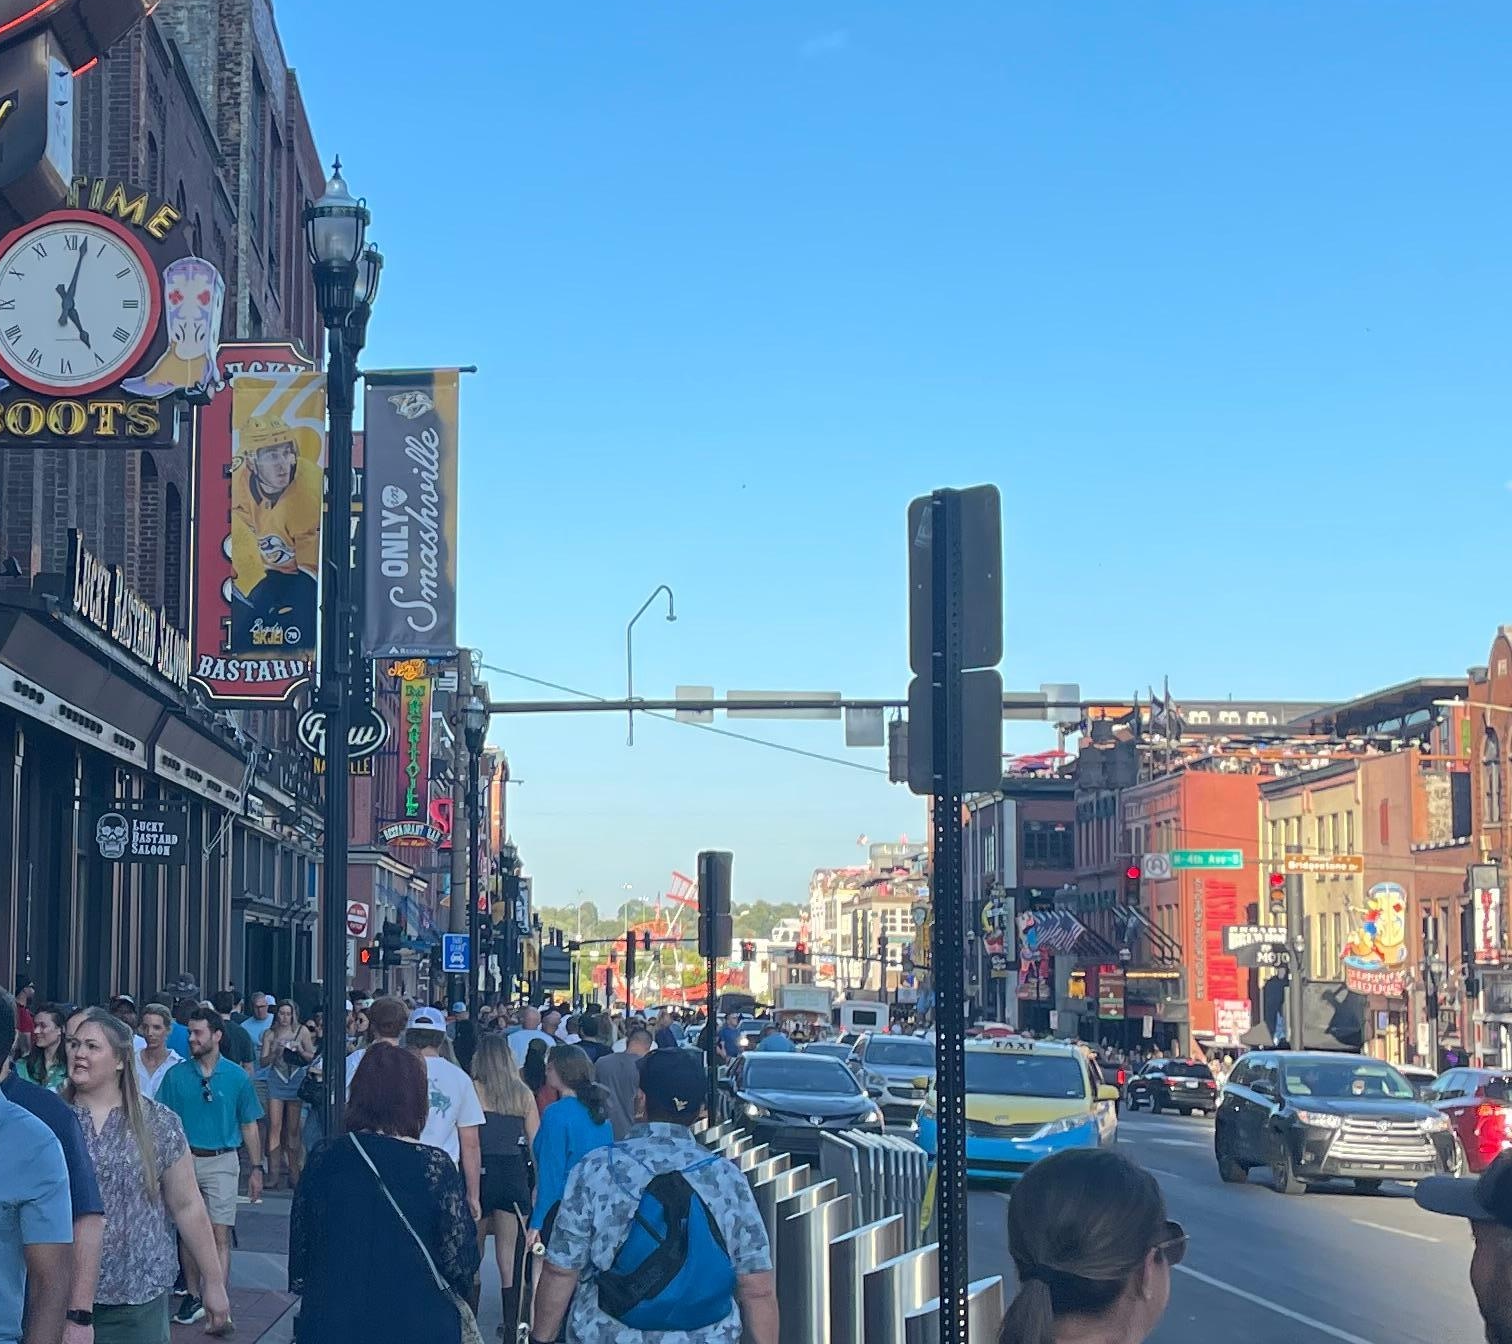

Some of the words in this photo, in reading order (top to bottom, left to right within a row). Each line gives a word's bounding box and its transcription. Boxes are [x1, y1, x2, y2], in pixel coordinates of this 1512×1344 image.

[66, 176, 181, 240] TIME
[389, 427, 439, 632] Smashville
[381, 510, 409, 578] ONLY
[196, 655, 304, 682] BASTARD
[132, 819, 164, 832] LUCKY
[132, 832, 178, 845] BASTARD
[132, 843, 171, 856] SALOON
[1256, 952, 1290, 966] MOJO
[993, 1039, 1033, 1051] TAXI
